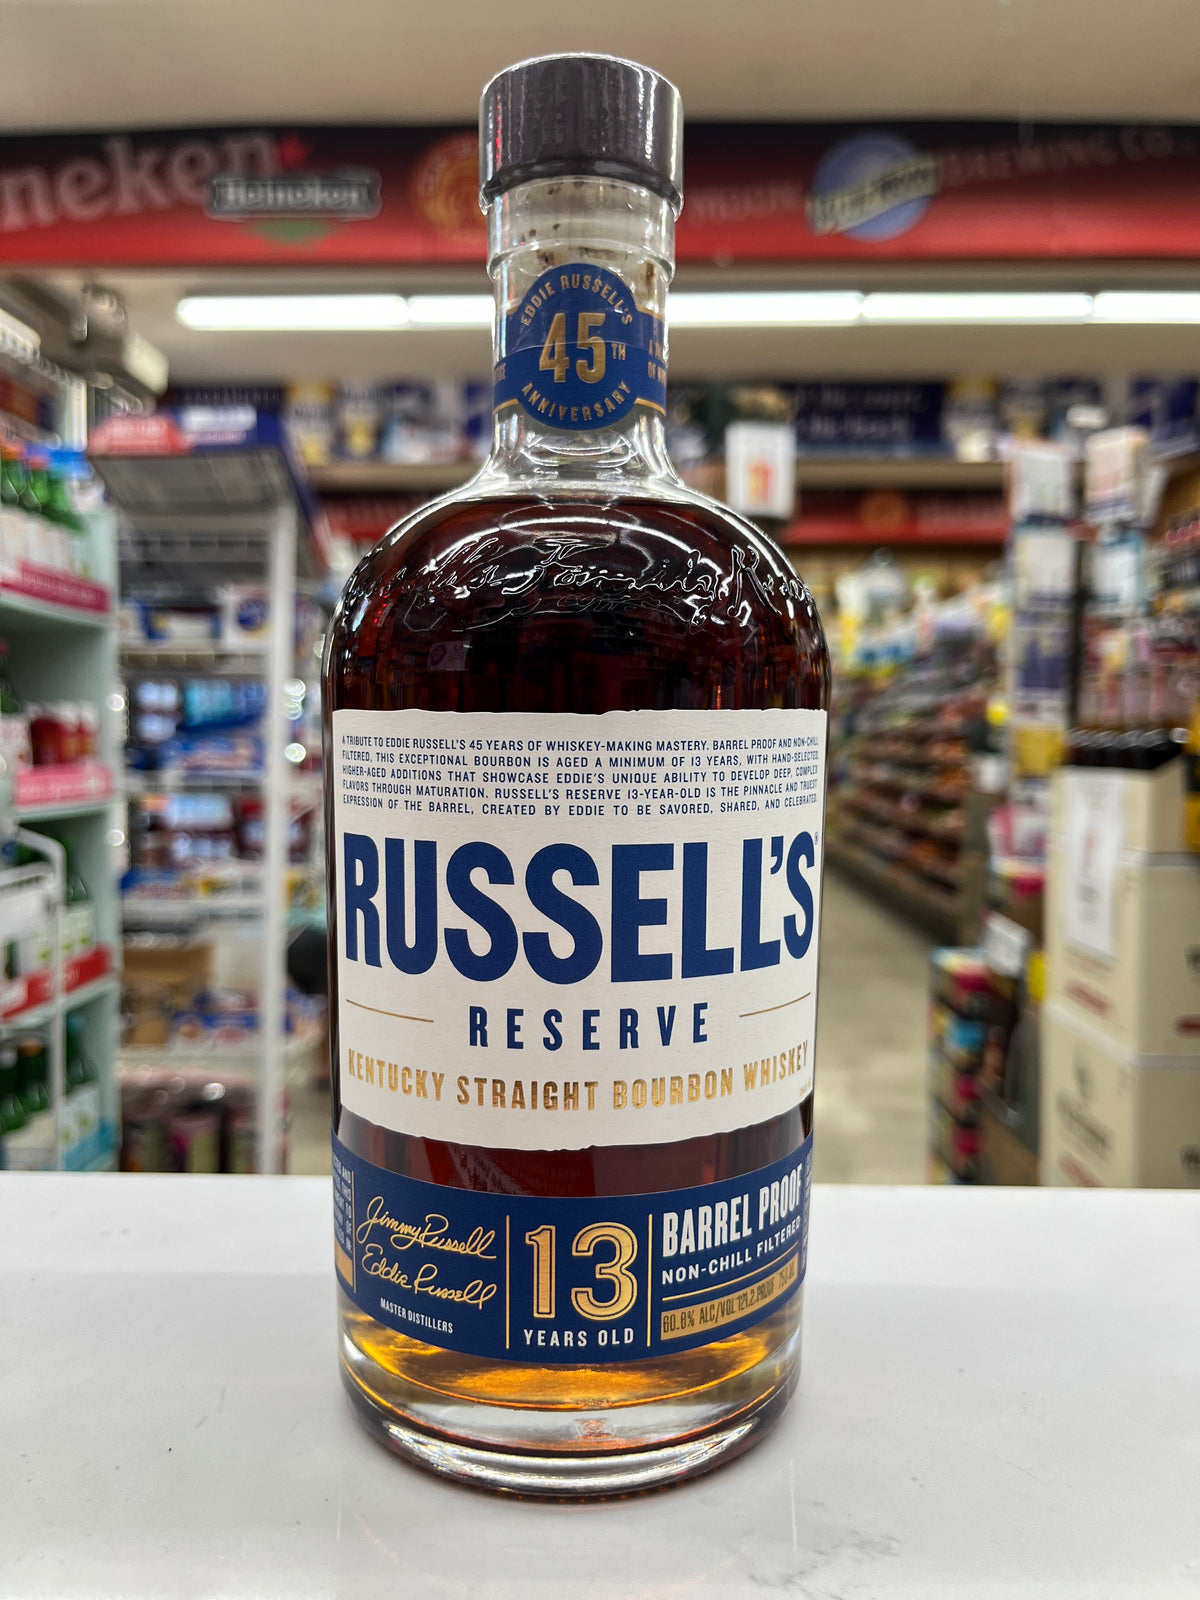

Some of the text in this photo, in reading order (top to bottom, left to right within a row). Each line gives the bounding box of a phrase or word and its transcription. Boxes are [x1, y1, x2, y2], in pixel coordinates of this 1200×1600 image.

[520, 273, 633, 326] EDDIE RUSSELL'S
[521, 380, 631, 422] ANNIVERSARY
[342, 736, 818, 752] A TRIBUTE TO EDDIE RUSSELL'S 45 YEARS OF WHISKEY-MAKING MASTERY. BARREL PROOF AND NON-CHILL
[342, 750, 372, 763] FILTERED,
[376, 752, 394, 764] THIS
[399, 754, 468, 766] EXCEPTIONAL
[474, 756, 531, 768] BOURBON
[538, 757, 550, 768] IS
[556, 757, 588, 768] AGED
[594, 757, 602, 768] A
[609, 757, 665, 768] MINIMUM
[672, 756, 685, 767] OF
[691, 756, 701, 767] 13
[706, 755, 742, 767] YEARS,
[747, 754, 768, 765] WITH
[342, 764, 818, 784] HIGHER-AGED ADDITIONS THAT SHOWCASE EDDIE'S UNIQUE ABILITY TO DEVELOP DEEP, COMPLEX
[342, 779, 818, 800] FLAVORS THROUGH MATURATION. RUSSELL'S RESERVE 13-YEAR-OLD IS THE PINNACLE AND TRUEST
[343, 794, 817, 816] EXPRESSION OF THE BARREL, CREATED BY EDDIE TO BE SAVORED, SHARED, AND CELEBRATED.
[343, 831, 815, 985] RUSSELL'S
[469, 1002, 708, 1050] RESERVE
[348, 1048, 445, 1102] KENTUCKY
[456, 1075, 599, 1111] STRAIGHT
[612, 1067, 733, 1111] BOURBON
[743, 1040, 809, 1091] WHISKEY
[662, 1193, 752, 1258] BARREL
[758, 1162, 803, 1231] PROOF
[662, 1215, 801, 1285] NON-CHILL FILTERED
[525, 1221, 638, 1321] 13
[380, 1297, 454, 1334] MASTER DISTILLERS
[698, 1298, 736, 1324] ALC/VOL
[523, 1328, 634, 1347] YEARS OLD
